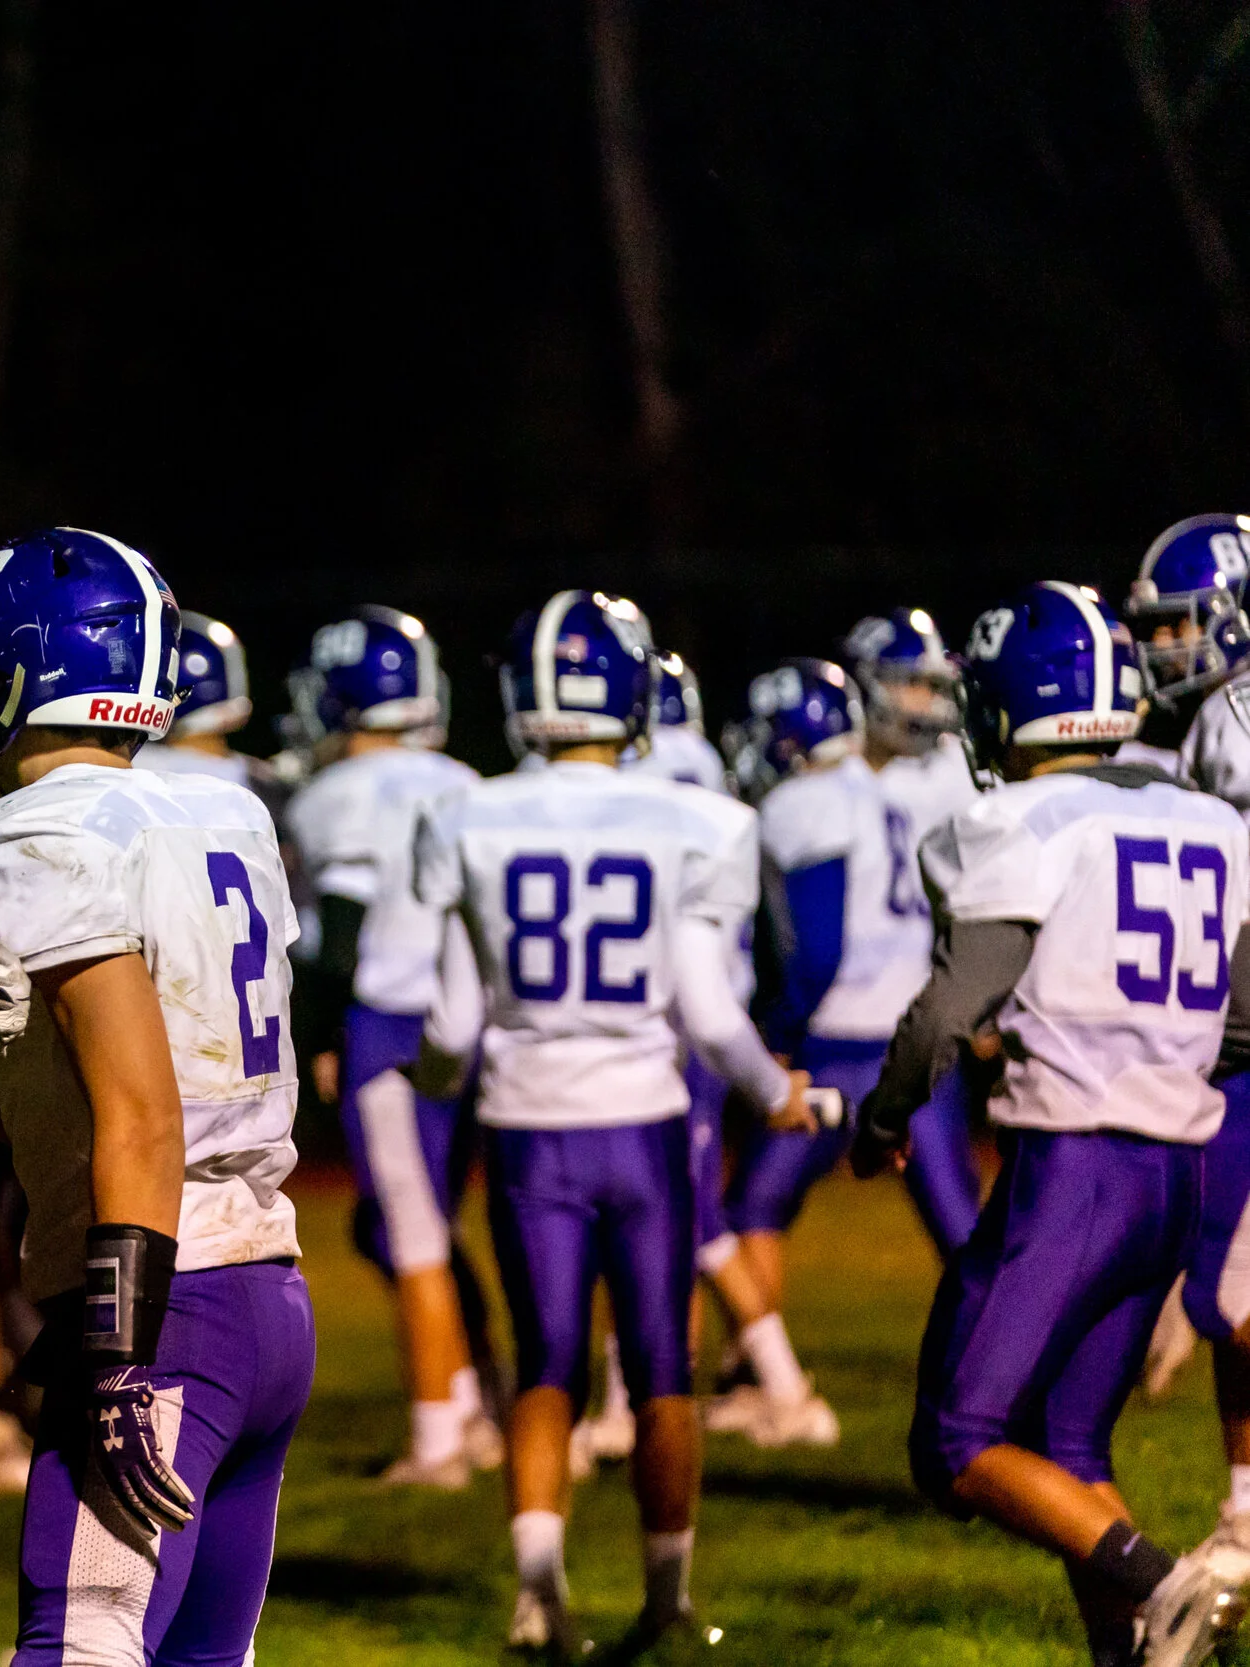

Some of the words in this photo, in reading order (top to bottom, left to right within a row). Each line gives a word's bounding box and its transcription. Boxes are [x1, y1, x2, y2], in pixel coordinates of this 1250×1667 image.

[88, 698, 173, 731] Riddell
[206, 852, 280, 1079] 2
[505, 851, 653, 1002] 82
[1114, 833, 1231, 1012] 53
